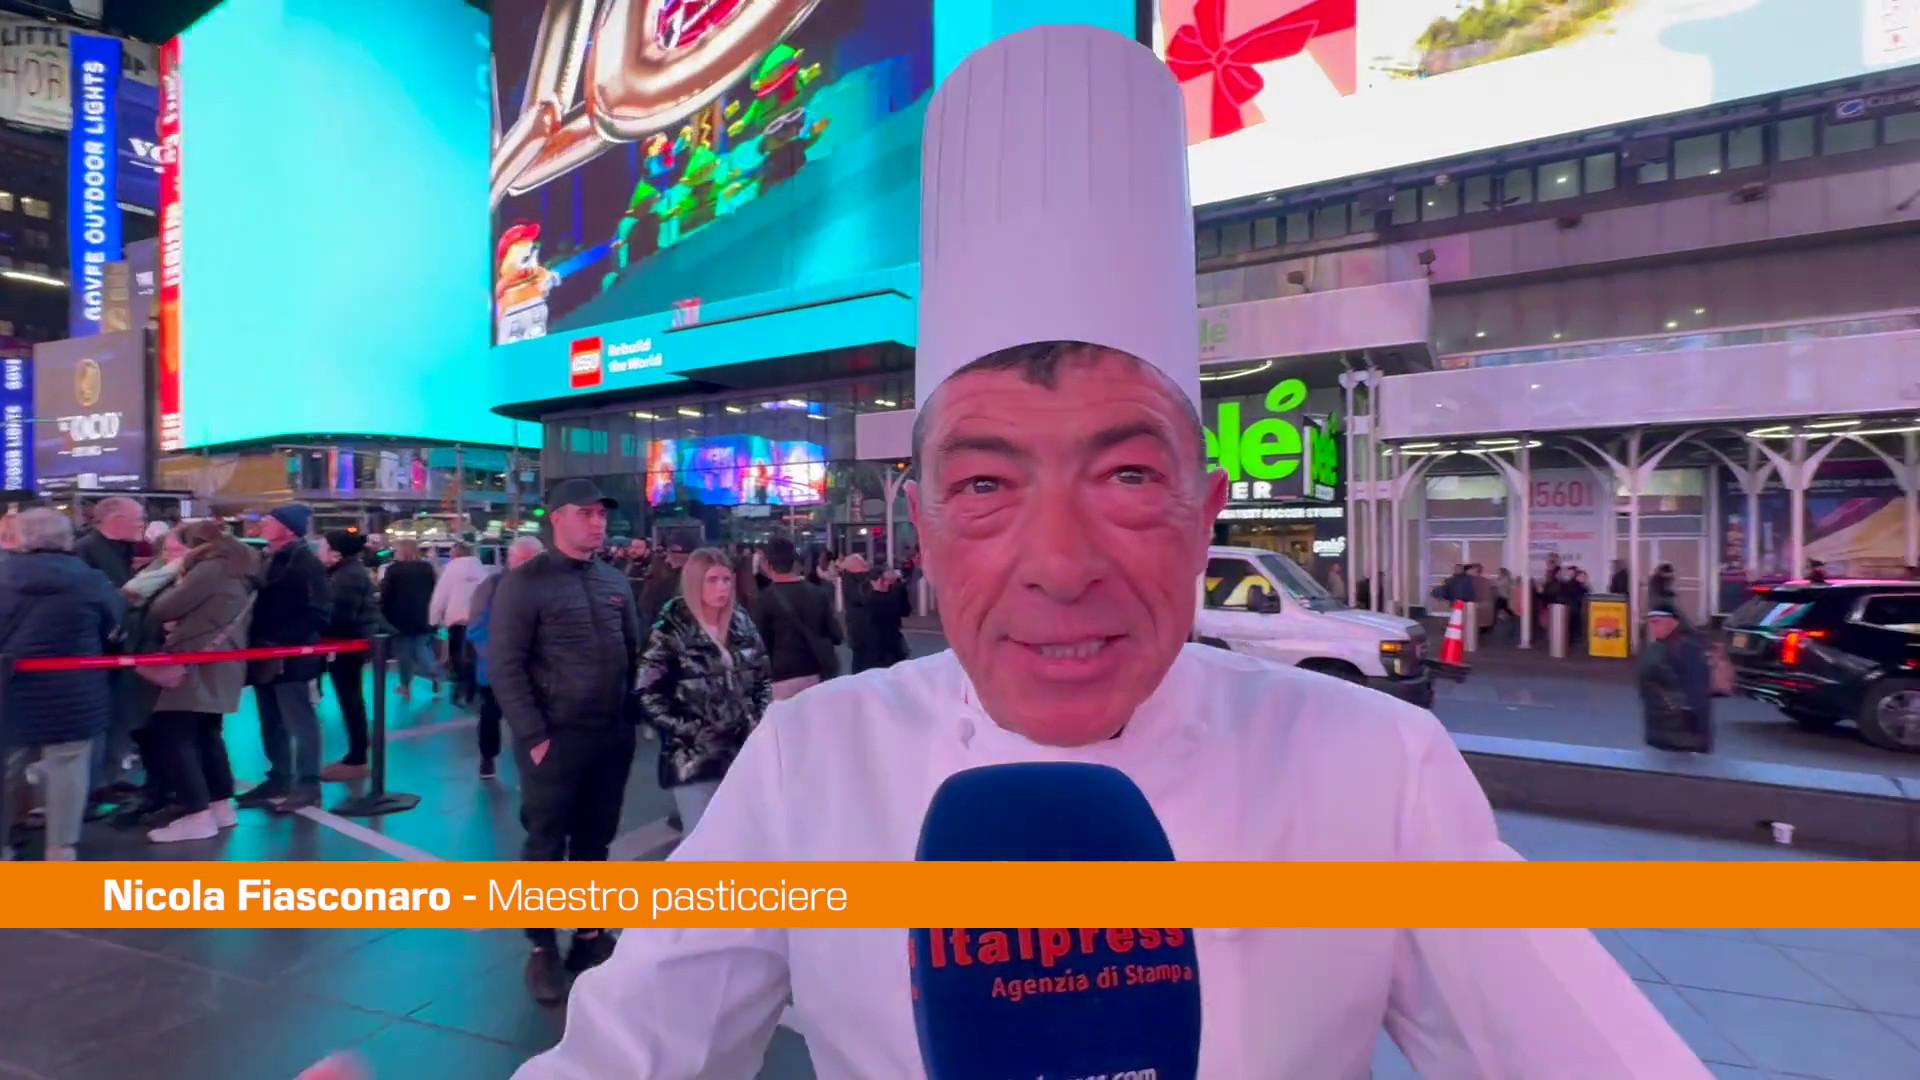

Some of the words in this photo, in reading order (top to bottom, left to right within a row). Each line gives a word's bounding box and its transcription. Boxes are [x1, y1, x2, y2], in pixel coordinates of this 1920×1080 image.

[82, 61, 106, 135] LIGHTS
[83, 140, 106, 244] OUTDOOR
[929, 928, 1185, 968] Italpress
[991, 969, 1089, 1002] Agenzia
[1096, 967, 1119, 989] di
[1125, 964, 1192, 986] Stampa
